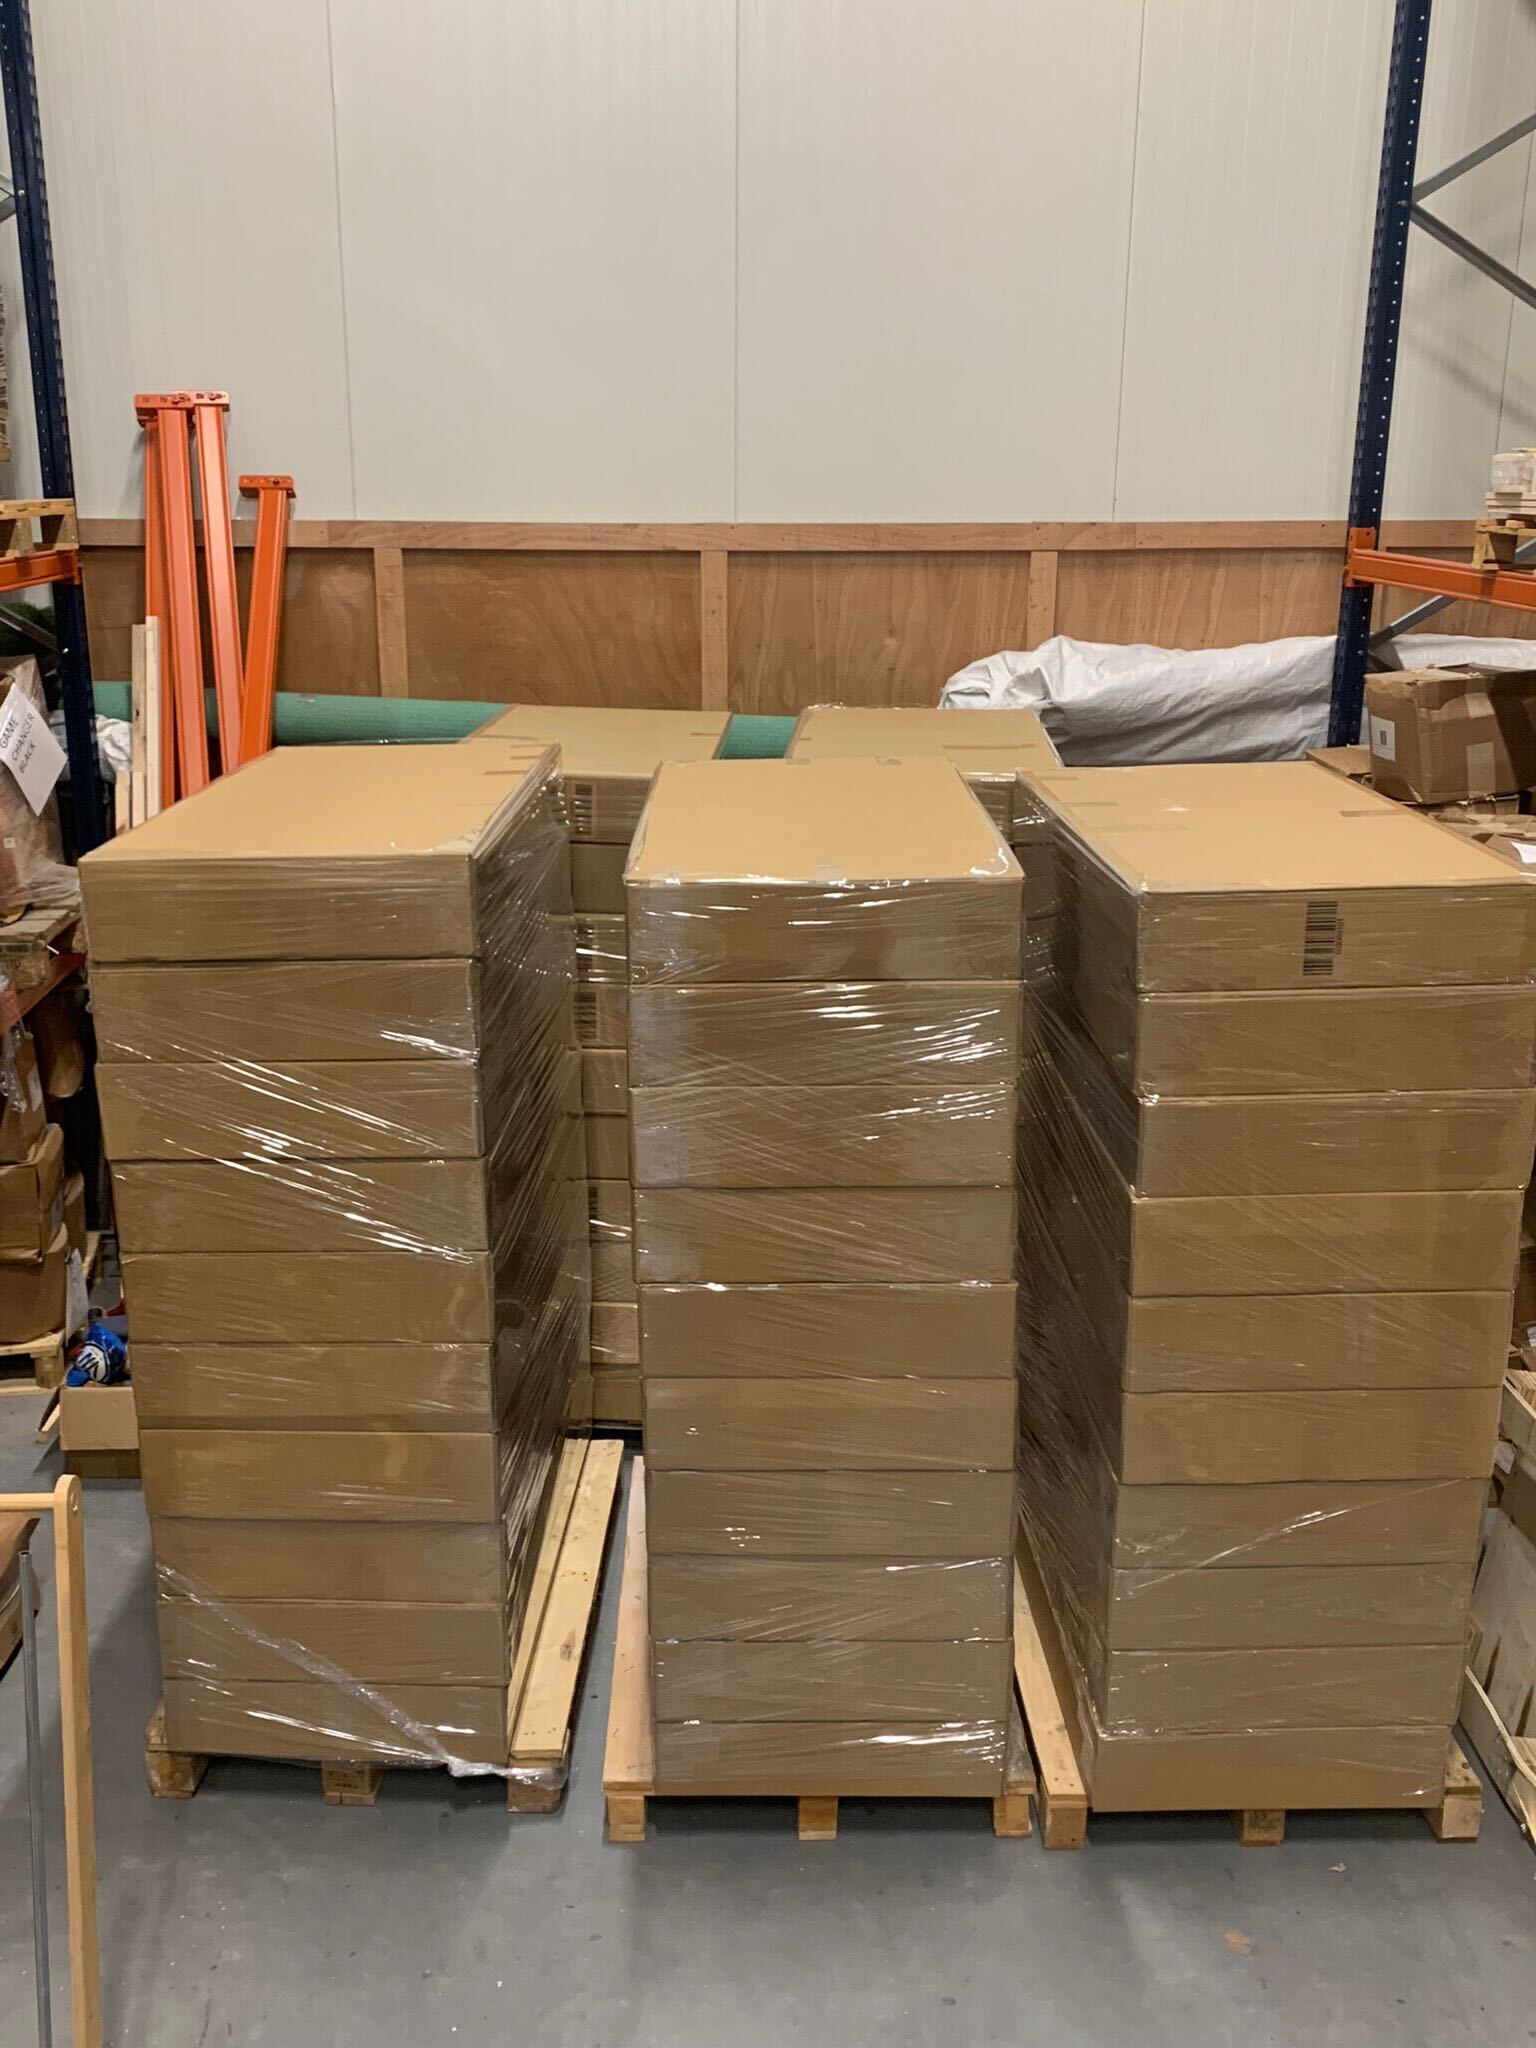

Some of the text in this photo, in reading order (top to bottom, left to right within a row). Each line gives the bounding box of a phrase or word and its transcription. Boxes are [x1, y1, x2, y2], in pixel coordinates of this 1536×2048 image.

[0, 716, 19, 749] GAME
[11, 712, 35, 761] CHANGER
[19, 741, 36, 774] BLACK
